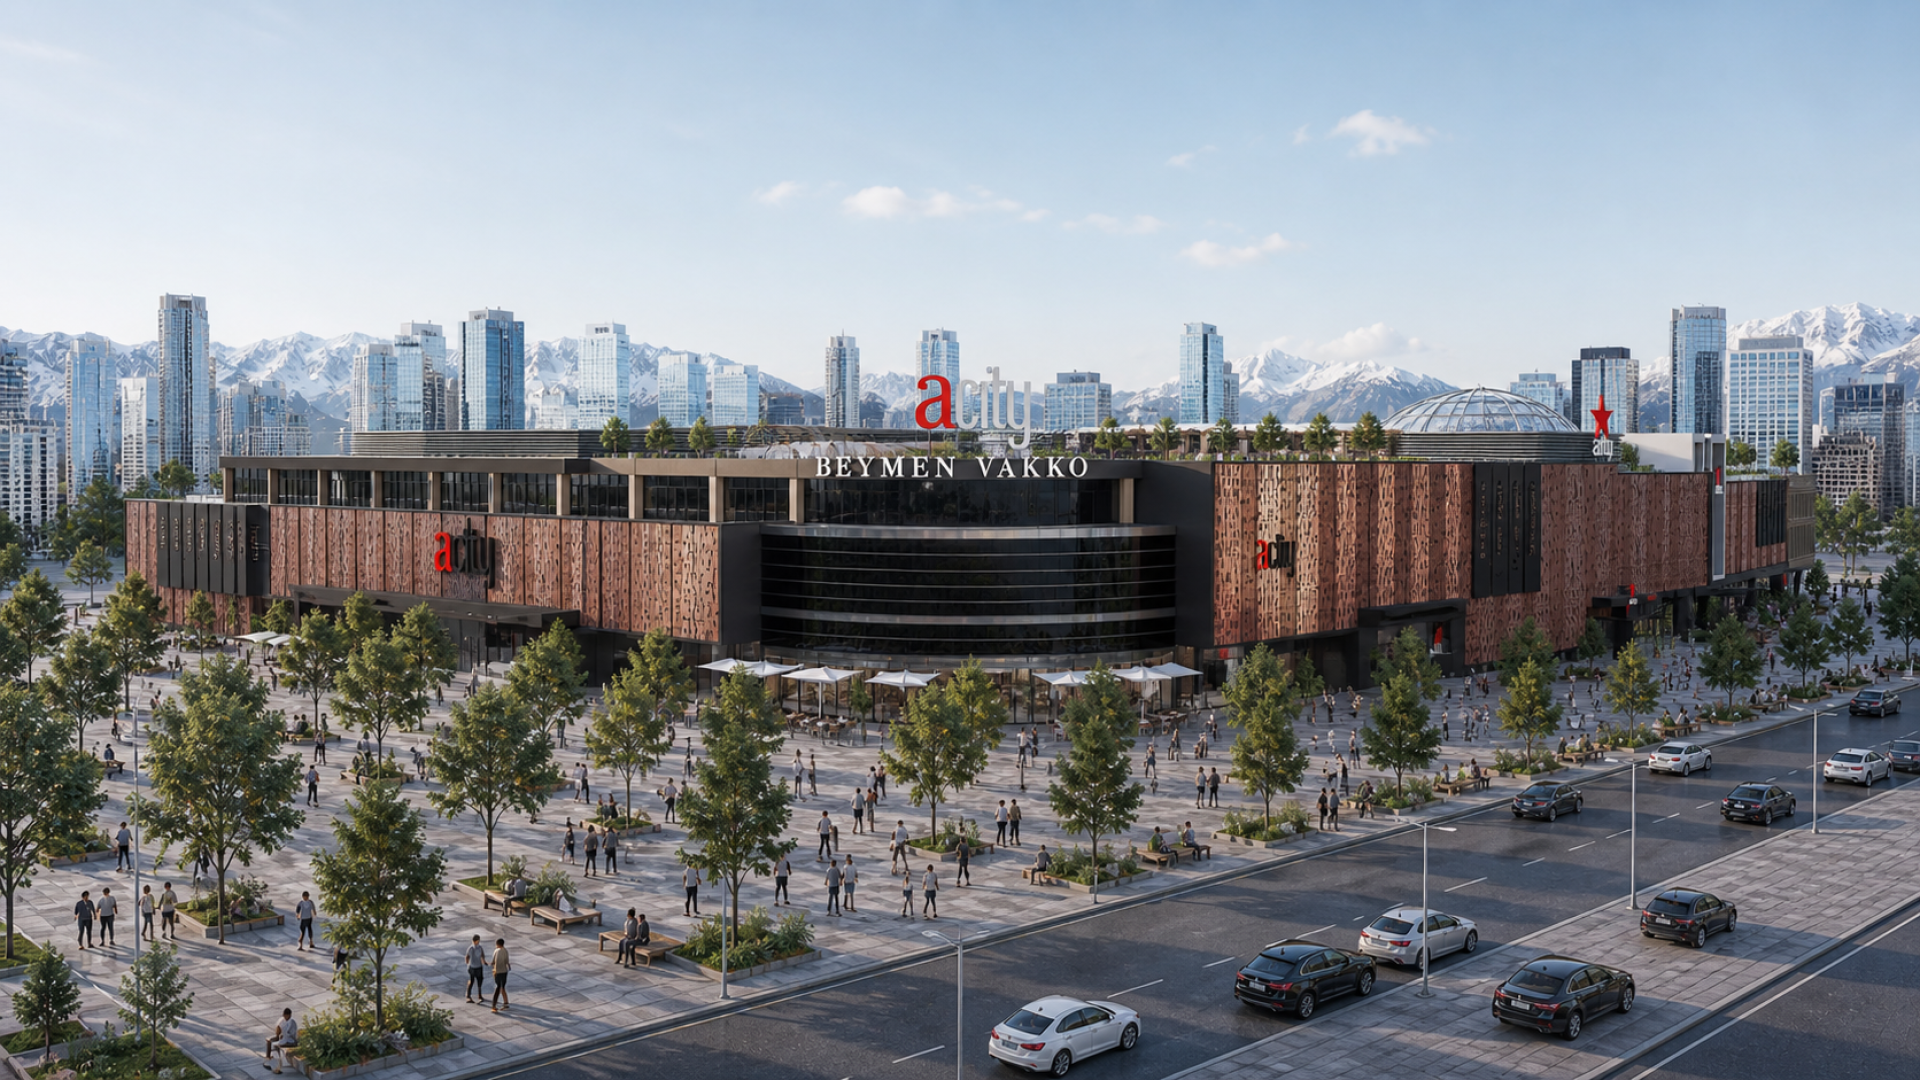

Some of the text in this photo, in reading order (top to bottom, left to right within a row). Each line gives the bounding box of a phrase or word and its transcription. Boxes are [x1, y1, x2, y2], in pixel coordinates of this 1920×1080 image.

[915, 366, 1031, 450] acity
[815, 456, 1089, 478] BEYMEN VAKKO
